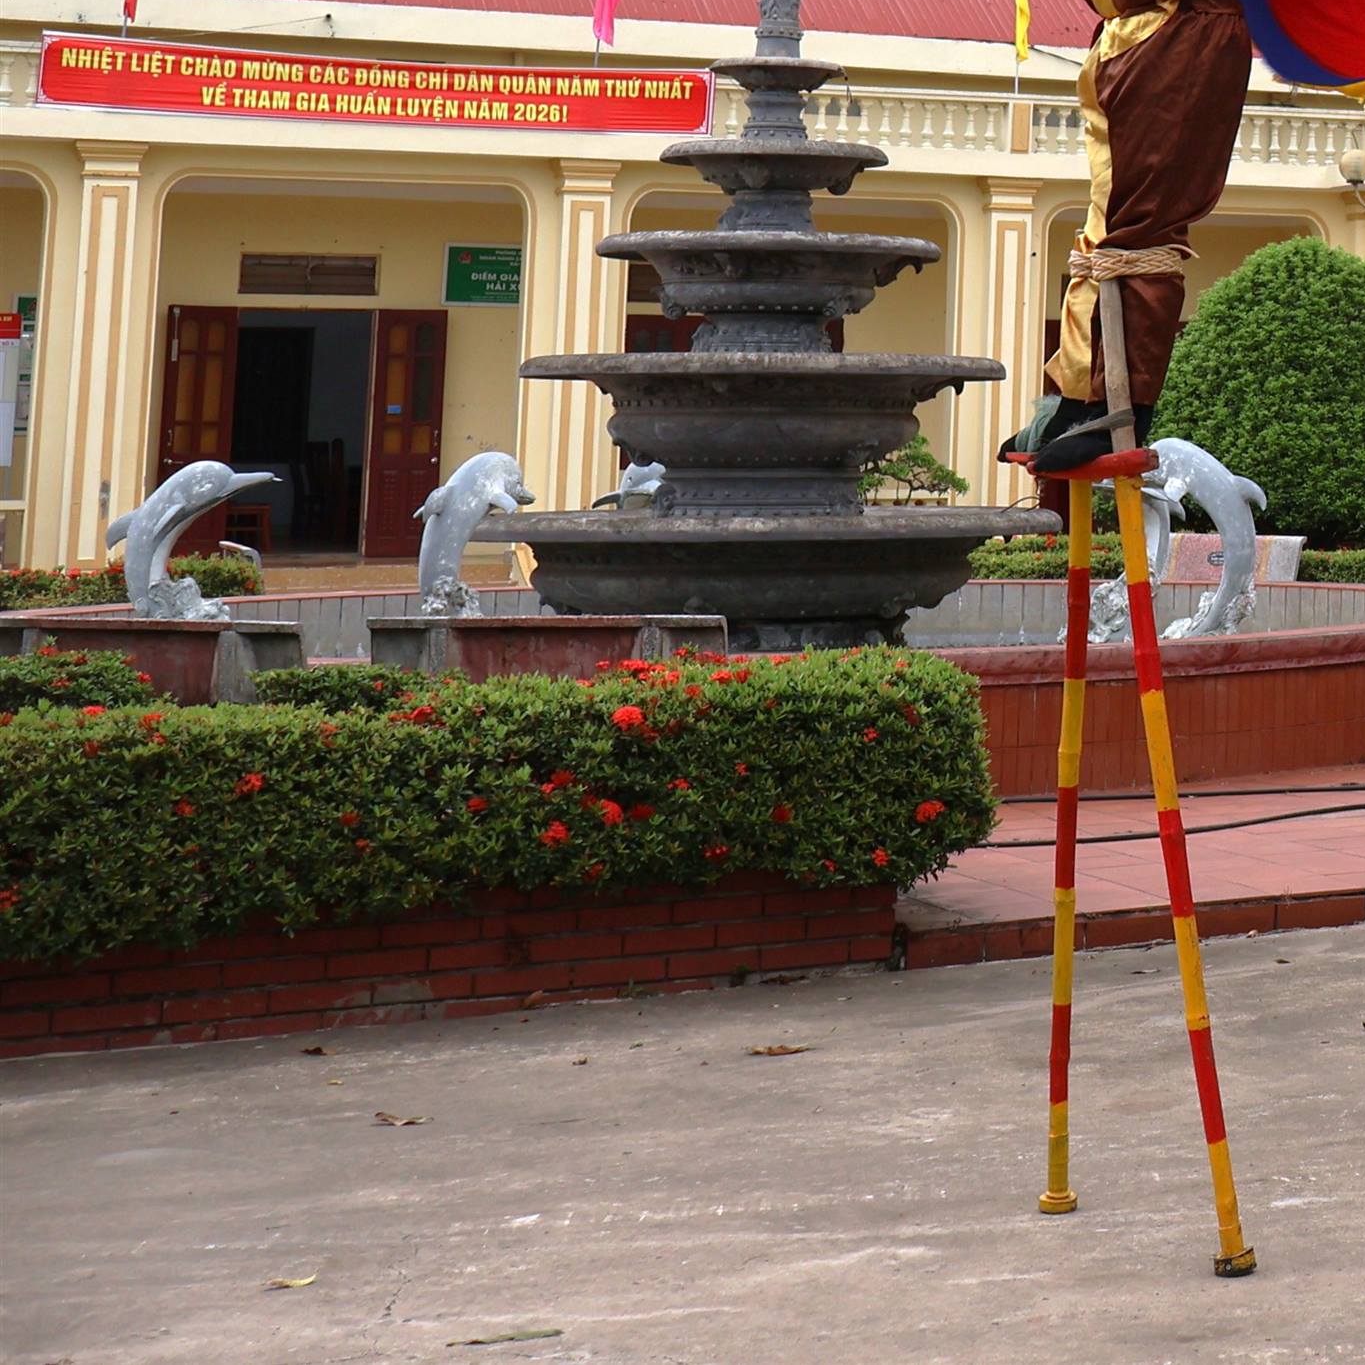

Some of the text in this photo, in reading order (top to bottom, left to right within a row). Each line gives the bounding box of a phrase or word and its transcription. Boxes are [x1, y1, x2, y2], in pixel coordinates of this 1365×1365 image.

[61, 46, 694, 100] NHIỆT LIỆT CHÀO MỪNG CÁC ĐỒNG CHÍ DÂN QUÂN NĂM THỨ NHẤT
[201, 81, 568, 124] VỀ THAM GIA HUẤN LUYỆN NĂM 2026!
[500, 273, 521, 281] GIA
